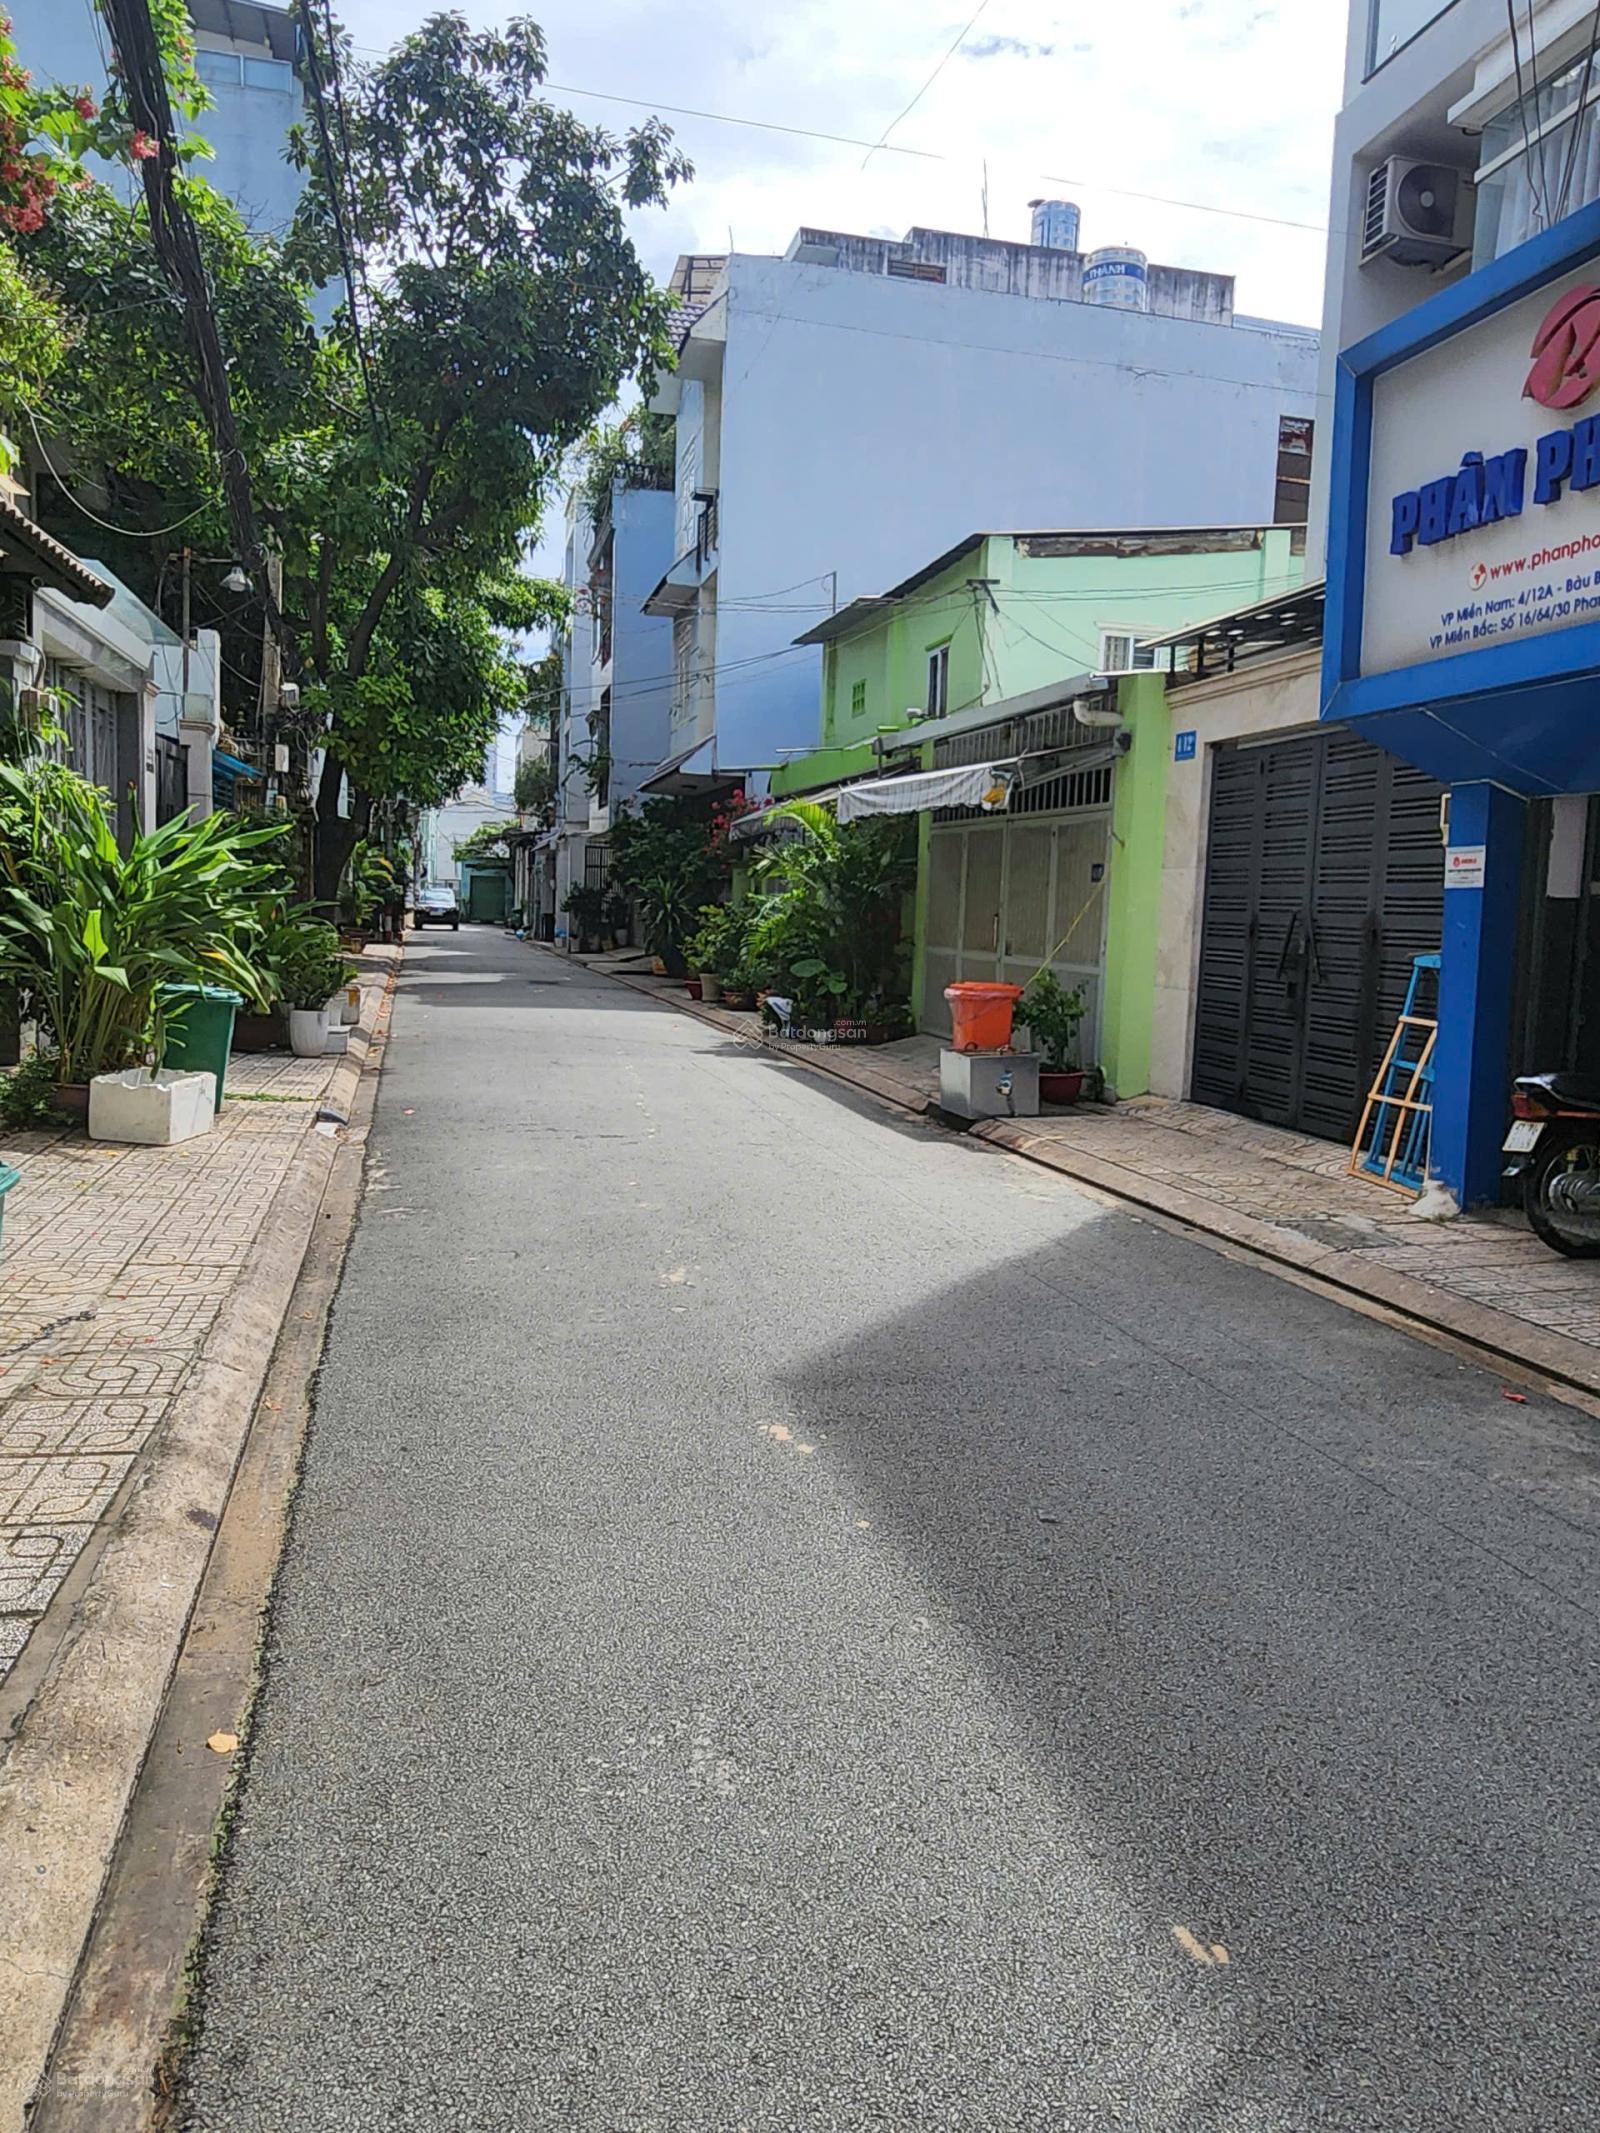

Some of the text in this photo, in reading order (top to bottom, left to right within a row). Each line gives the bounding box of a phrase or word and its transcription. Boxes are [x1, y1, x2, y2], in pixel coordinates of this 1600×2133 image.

[1390, 448, 1528, 555] PHÂN
[1430, 634, 1443, 650] VP
[1501, 612, 1516, 631] Số
[1519, 601, 1570, 627] 16/64/30
[1441, 611, 1454, 627] VP
[1485, 597, 1515, 615] Nam:
[1518, 584, 1553, 606] 4/12A
